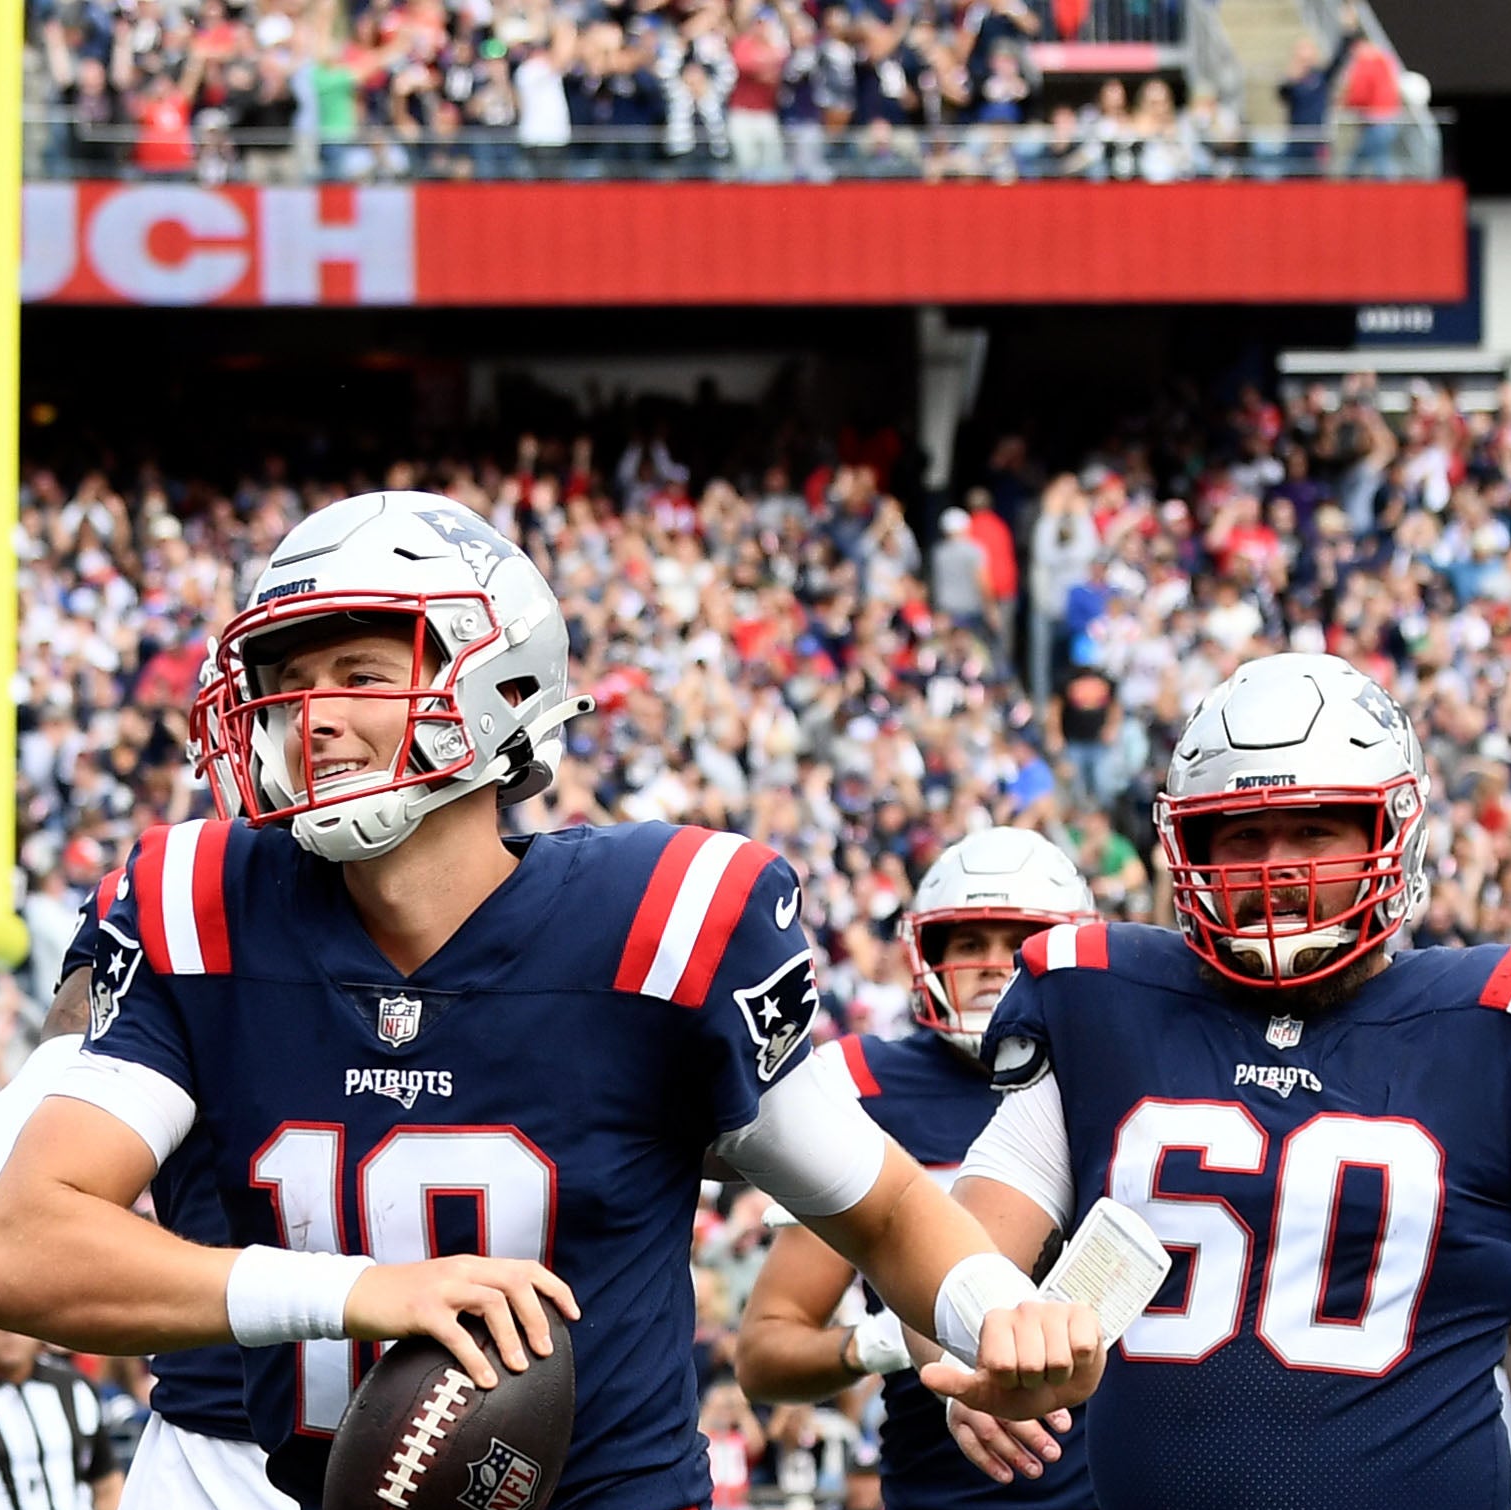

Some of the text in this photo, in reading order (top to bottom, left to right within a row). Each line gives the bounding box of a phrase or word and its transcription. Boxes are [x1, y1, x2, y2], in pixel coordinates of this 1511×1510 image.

[1235, 774, 1297, 790] PATRIOTS
[345, 1068, 453, 1098] PATRIOTS
[1233, 1063, 1323, 1093] PATRIOTS
[1104, 1095, 1446, 1378] 60
